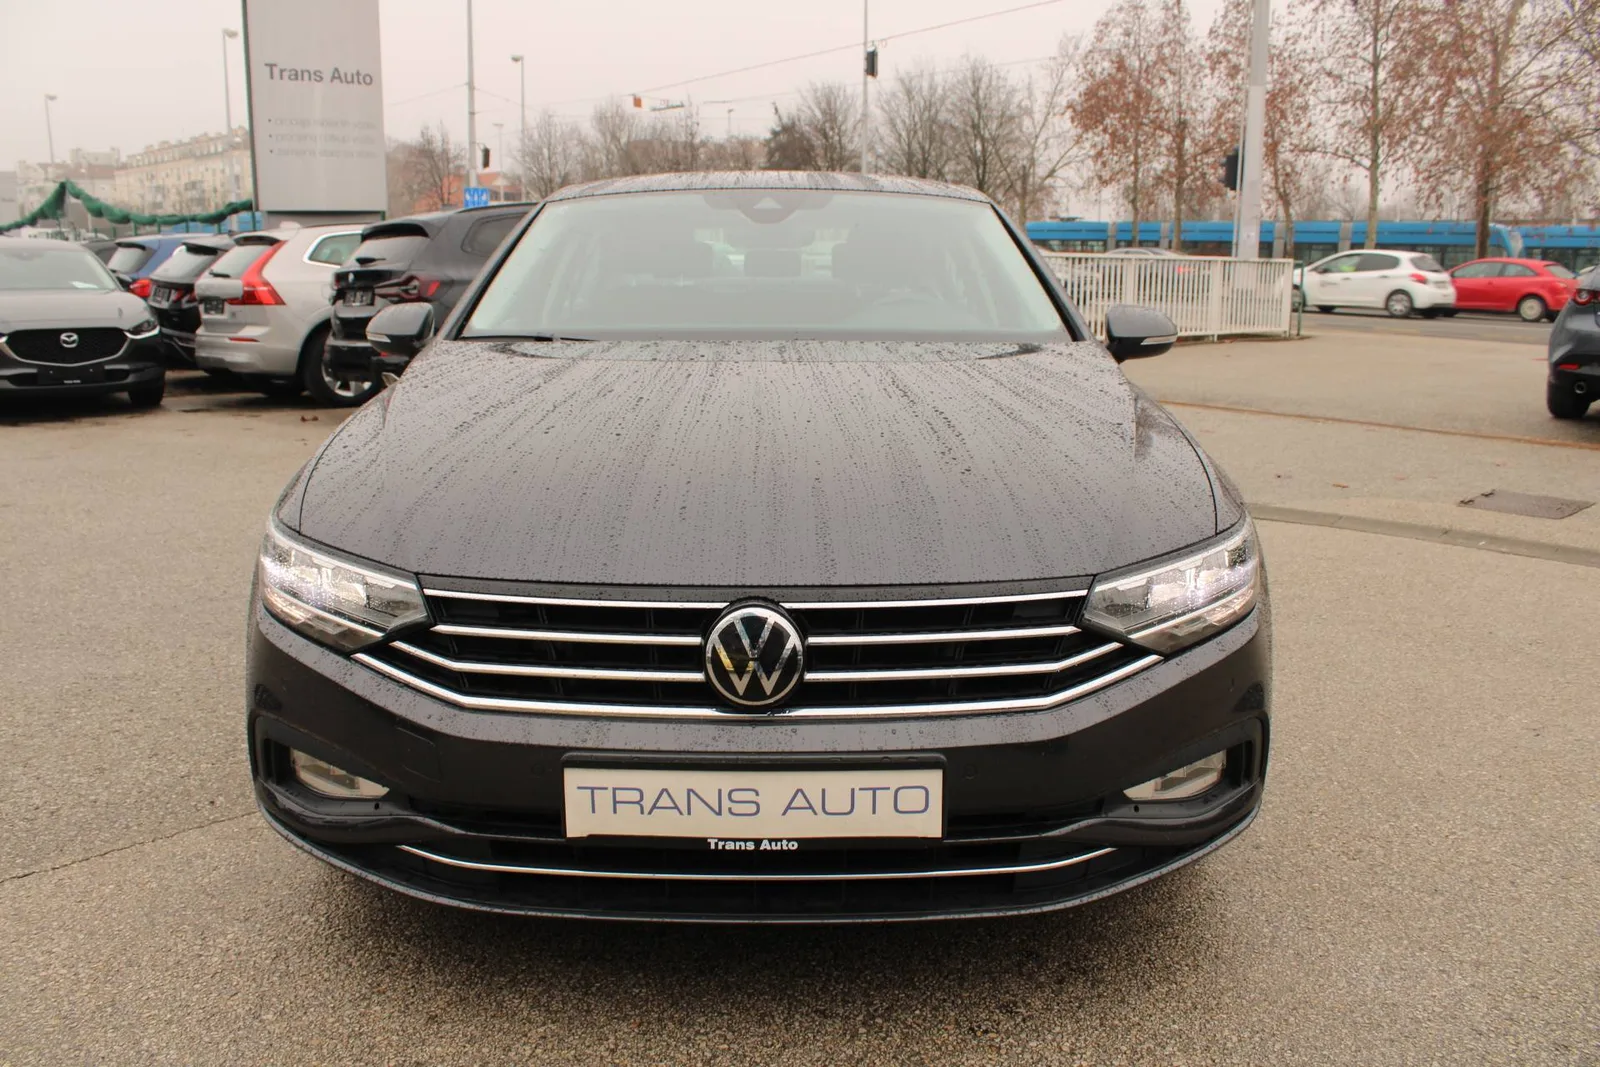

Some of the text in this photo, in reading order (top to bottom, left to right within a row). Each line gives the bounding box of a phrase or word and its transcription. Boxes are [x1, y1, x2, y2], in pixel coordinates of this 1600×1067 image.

[264, 63, 373, 86] Trans Auto
[709, 611, 800, 700] VW
[577, 785, 930, 817] TRANS AUTO
[707, 838, 799, 850] Trans Auto
